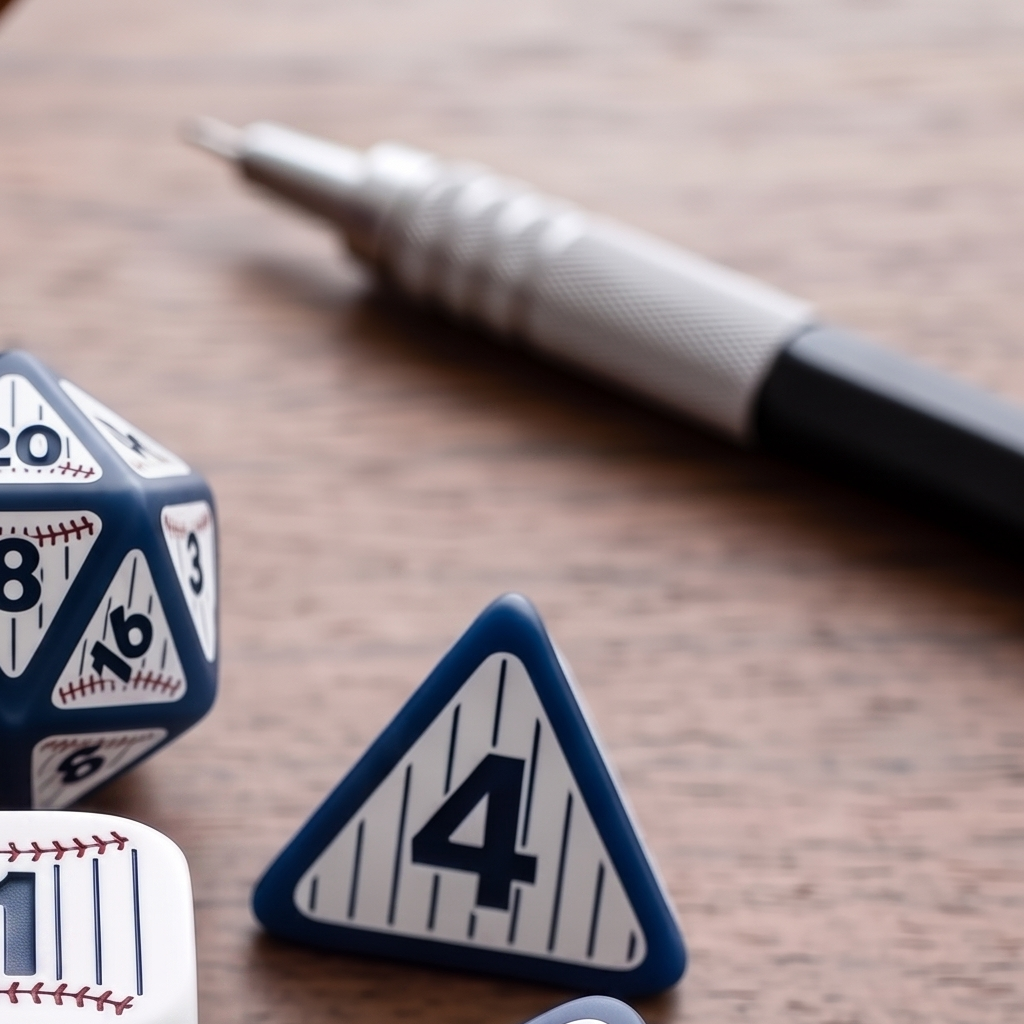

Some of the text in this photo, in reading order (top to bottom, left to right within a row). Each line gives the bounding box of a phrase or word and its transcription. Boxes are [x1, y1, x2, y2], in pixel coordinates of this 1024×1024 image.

[186, 532, 204, 596] 3
[90, 605, 153, 683] 16
[412, 754, 537, 912] 4
